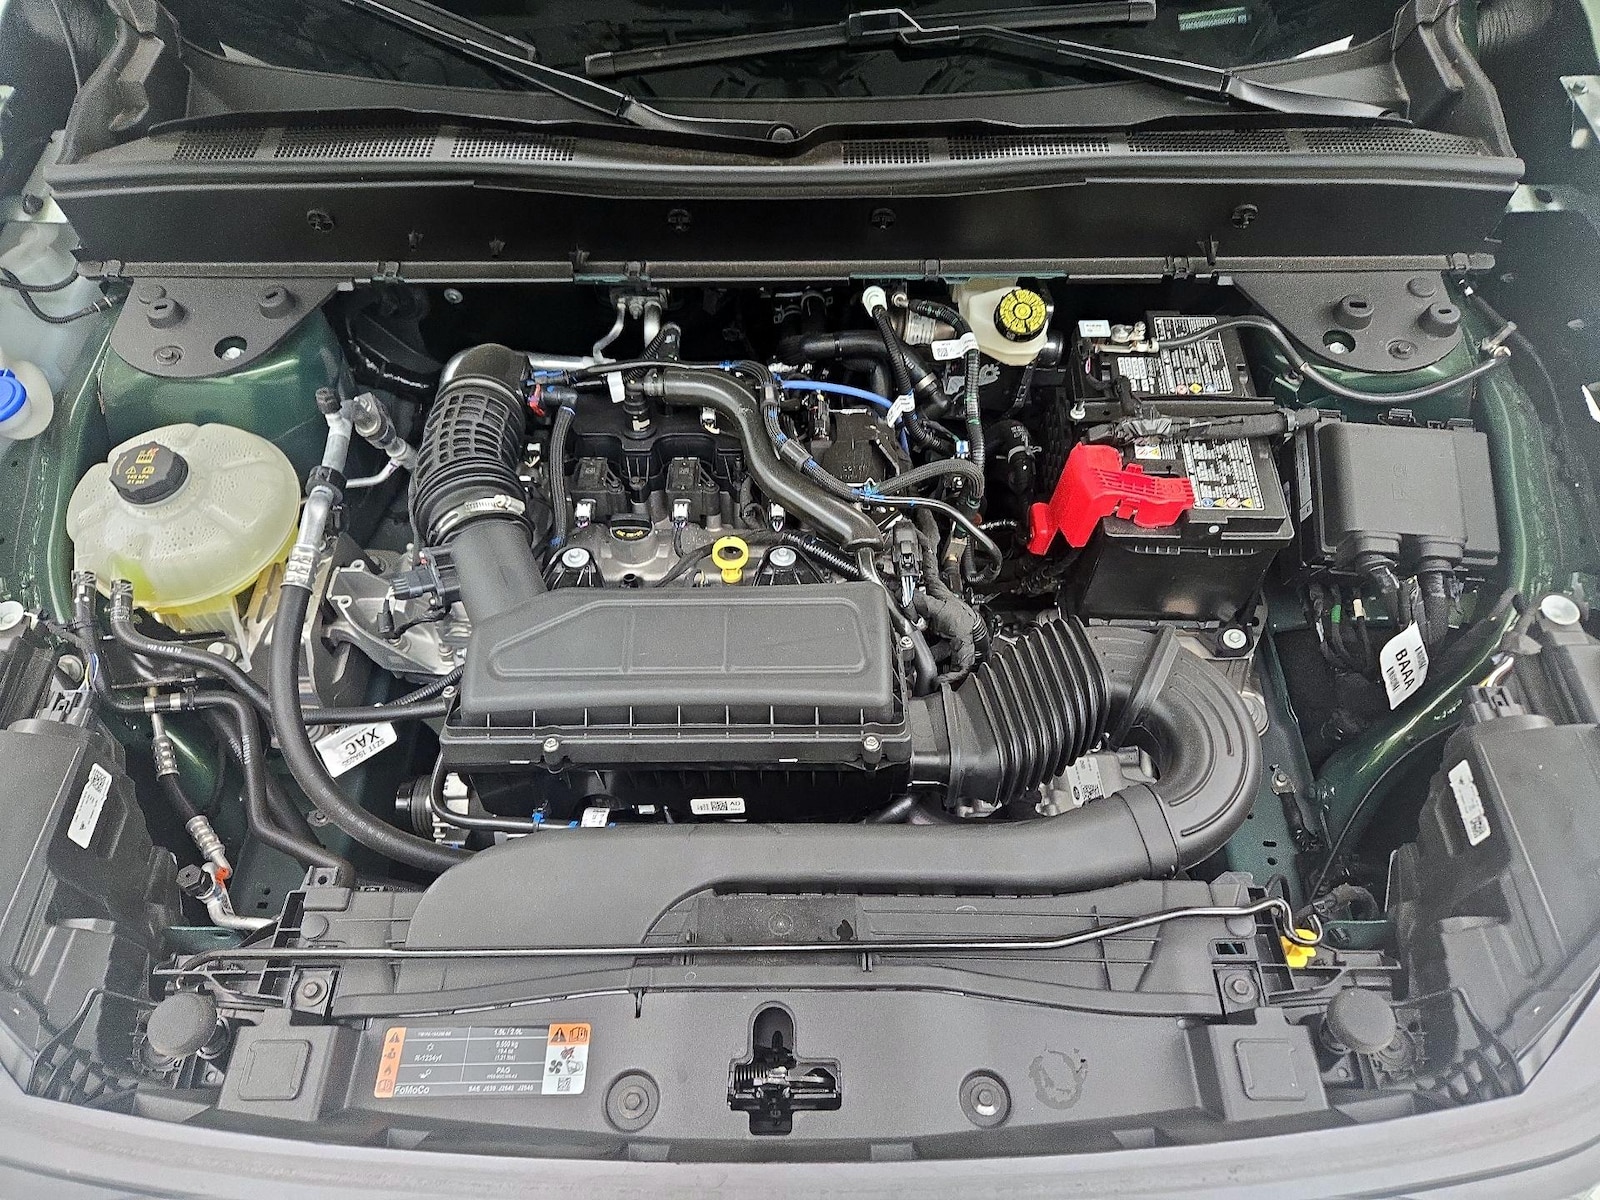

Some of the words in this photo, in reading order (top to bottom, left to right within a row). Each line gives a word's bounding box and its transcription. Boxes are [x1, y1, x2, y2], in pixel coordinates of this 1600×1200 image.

[1395, 648, 1415, 690] BAAA
[345, 727, 380, 756] XAC
[394, 1085, 430, 1095] FoMoCo
